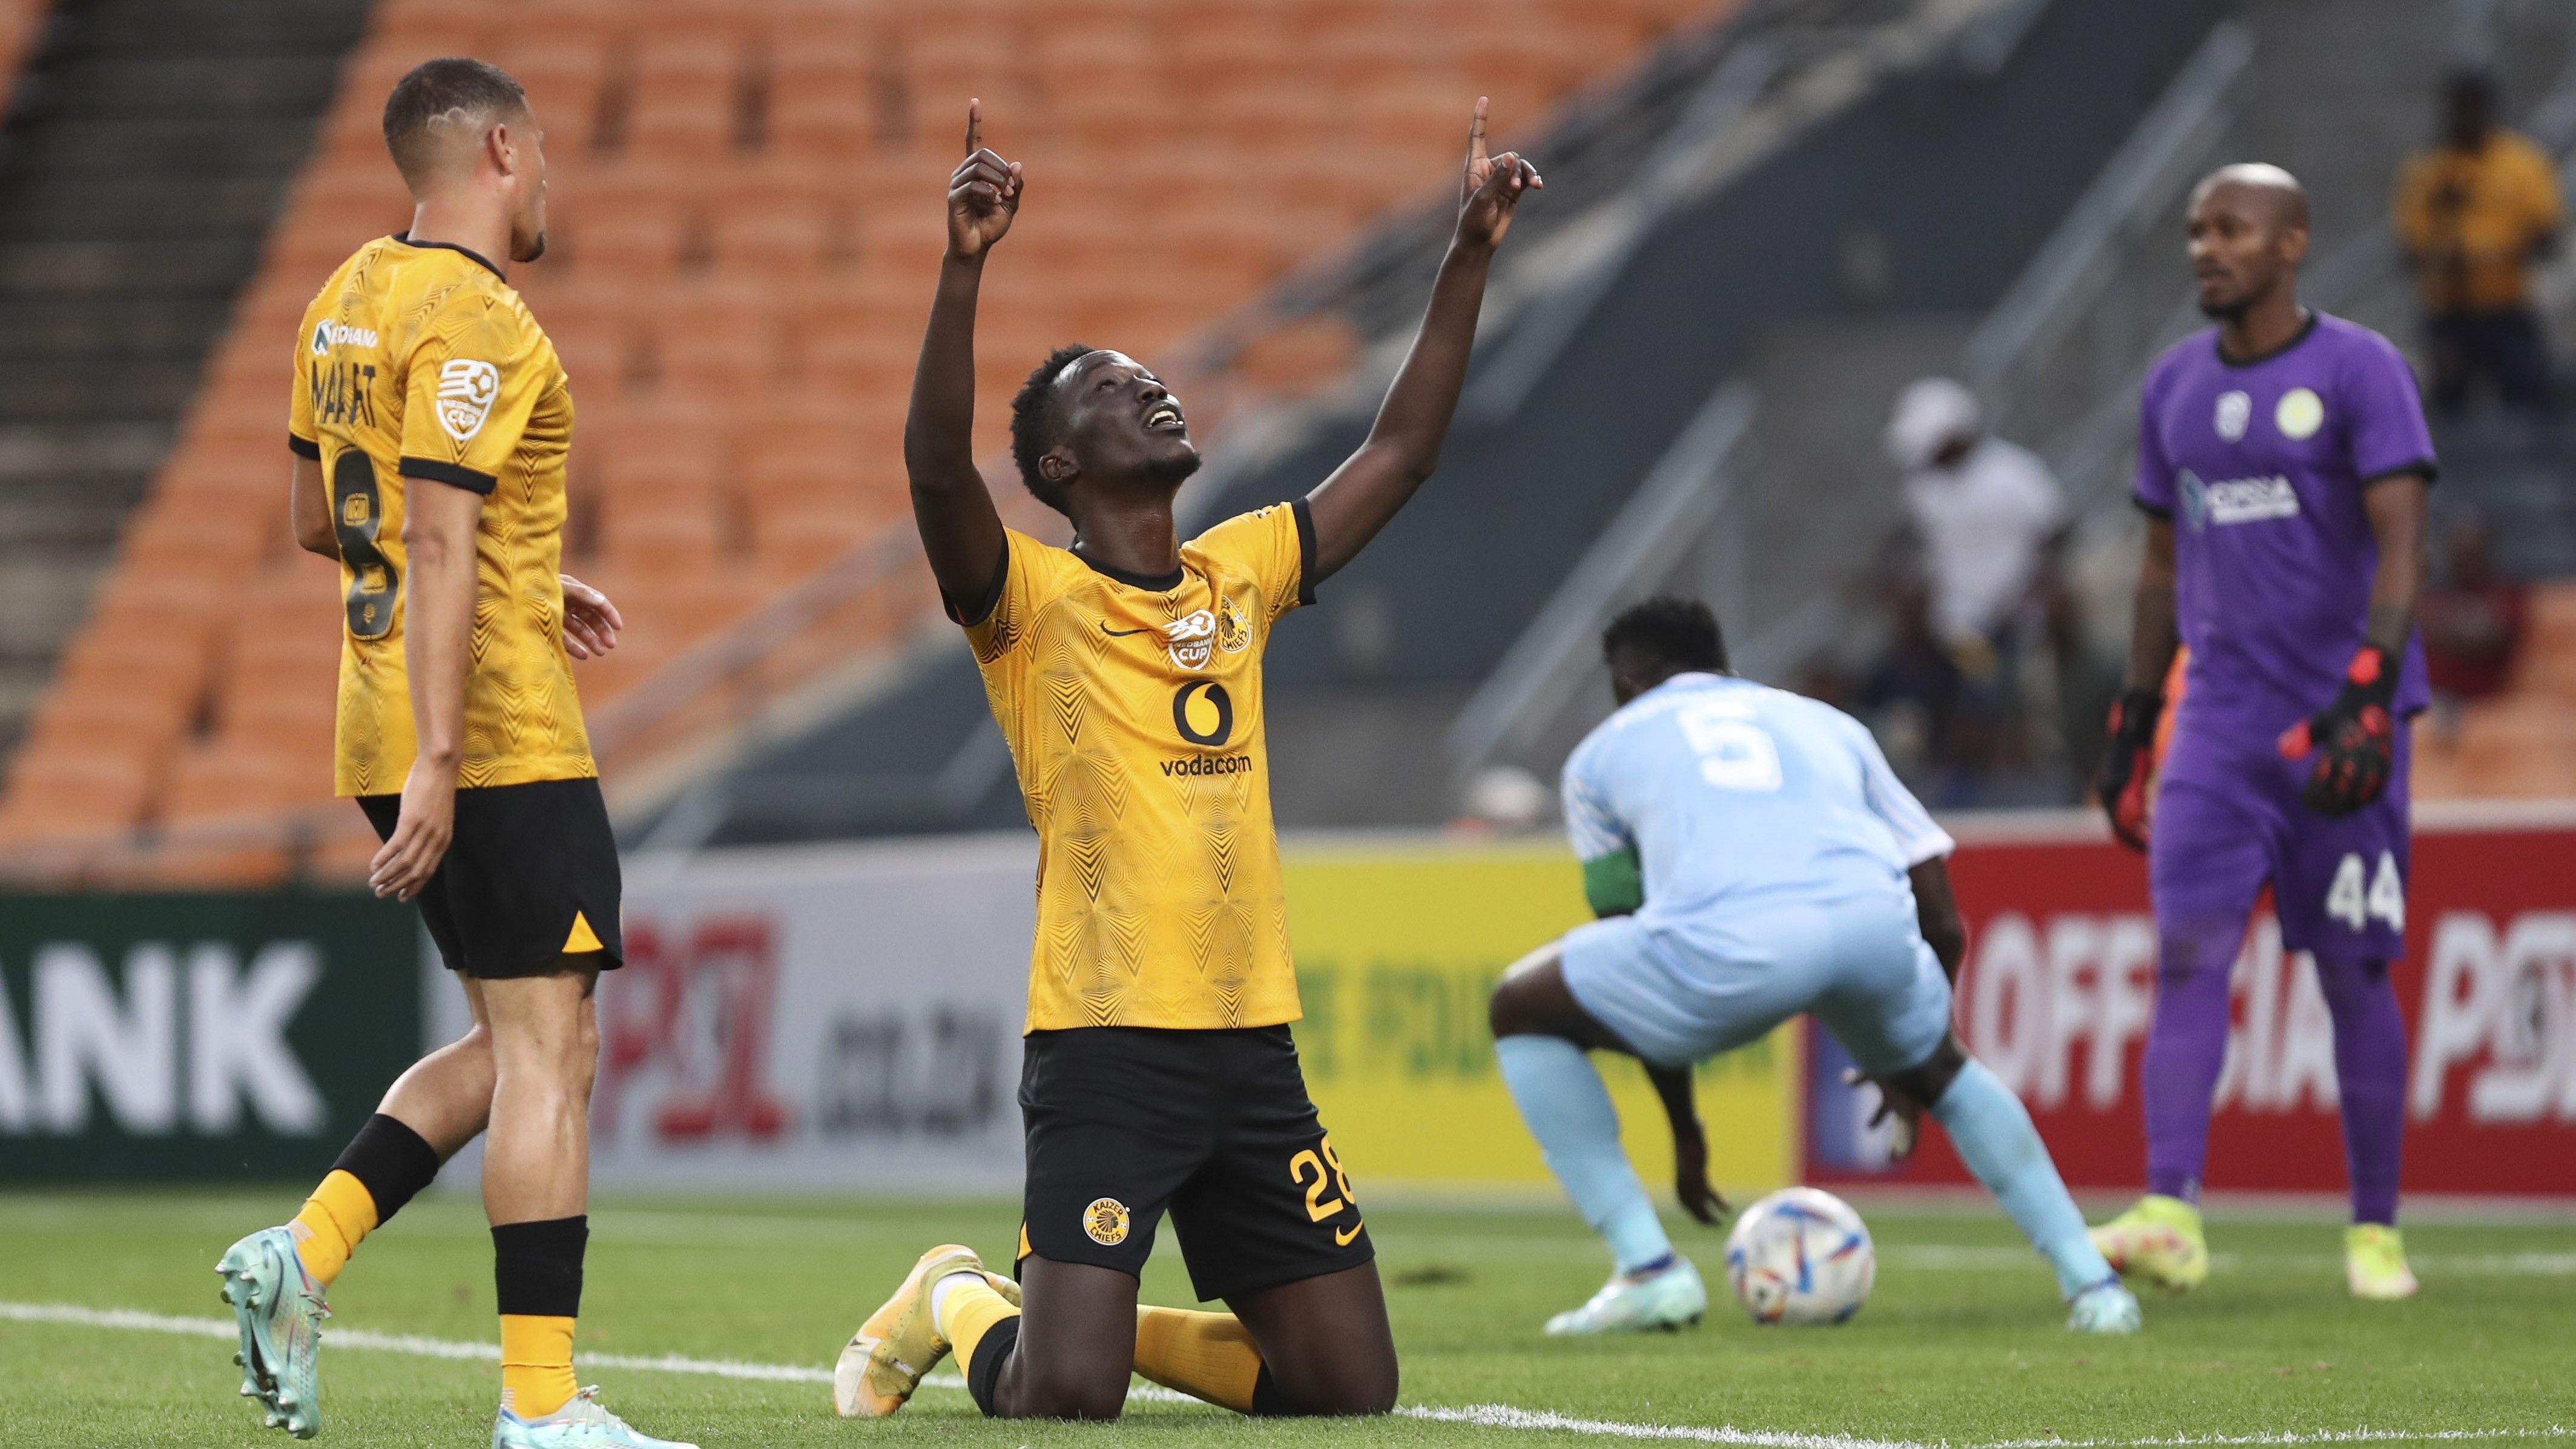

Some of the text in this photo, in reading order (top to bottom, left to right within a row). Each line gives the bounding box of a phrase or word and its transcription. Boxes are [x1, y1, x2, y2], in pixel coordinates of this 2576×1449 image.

[447, 409, 476, 426] CUP
[333, 447, 400, 641] 8
[1222, 629, 1247, 650] CHIEFS
[1178, 647, 1208, 660] CUP
[1677, 699, 1784, 792] 5
[1159, 754, 1253, 776] vodacom
[2325, 849, 2405, 932] 44
[1289, 1136, 1357, 1222] 28
[1093, 1201, 1124, 1217] KAIZER
[1090, 1226, 1121, 1242] CHIEFS
